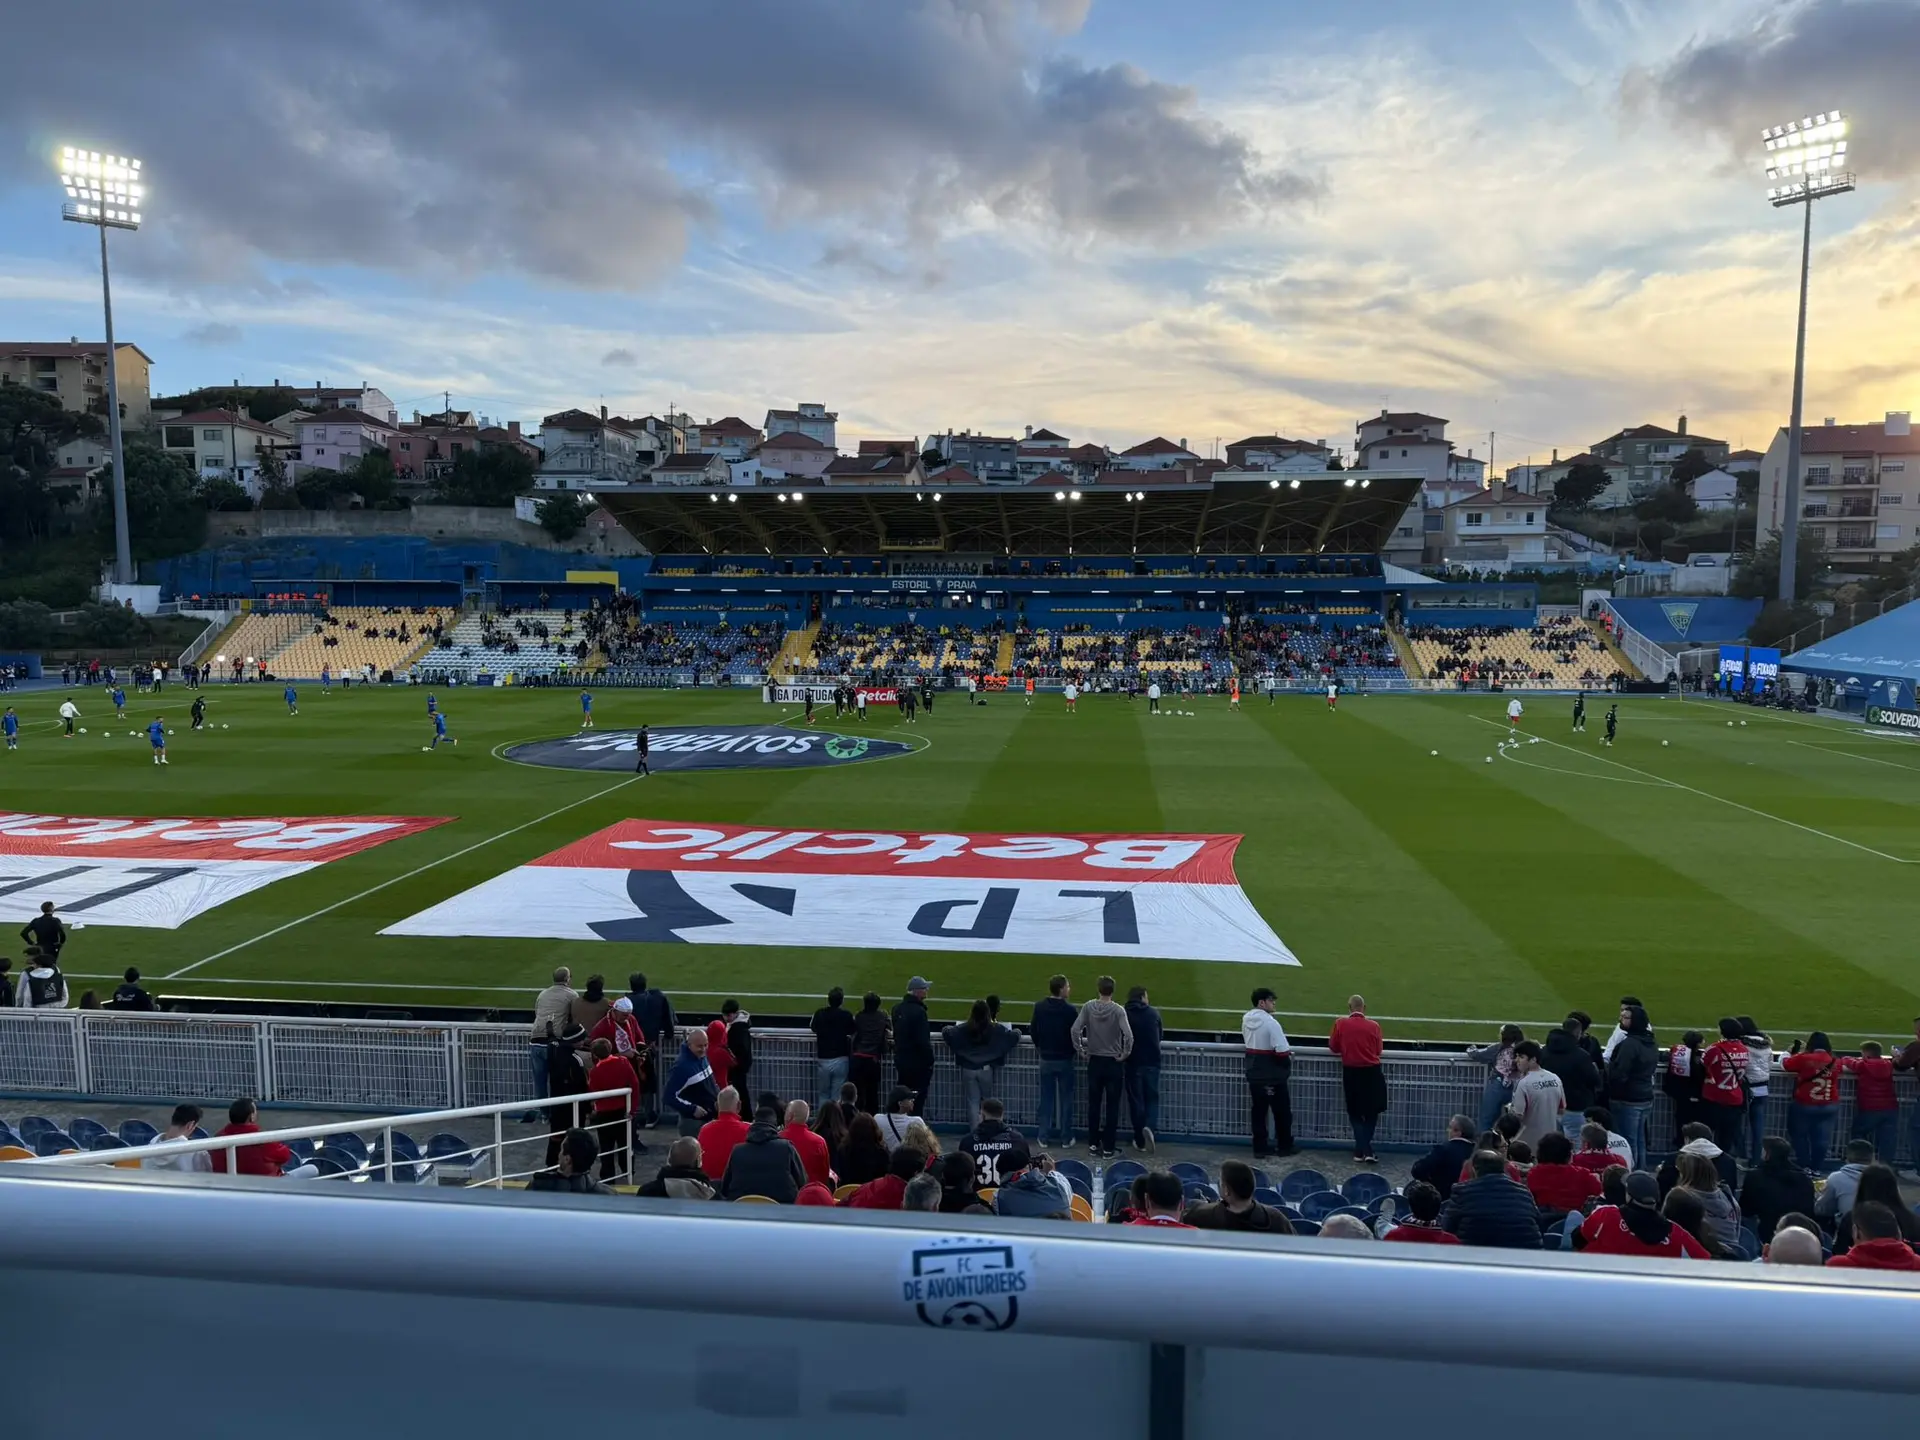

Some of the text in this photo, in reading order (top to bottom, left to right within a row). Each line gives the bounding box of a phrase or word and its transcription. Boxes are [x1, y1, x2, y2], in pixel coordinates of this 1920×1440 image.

[892, 580, 977, 589] ESTORIL PRAIA
[772, 688, 836, 701] IGA POTUGA
[609, 828, 1206, 870] Betclic
[973, 1142, 1013, 1152] OTAMENDI
[957, 1257, 972, 1273] FC
[903, 1270, 1026, 1301] DE AVONTURIERS
